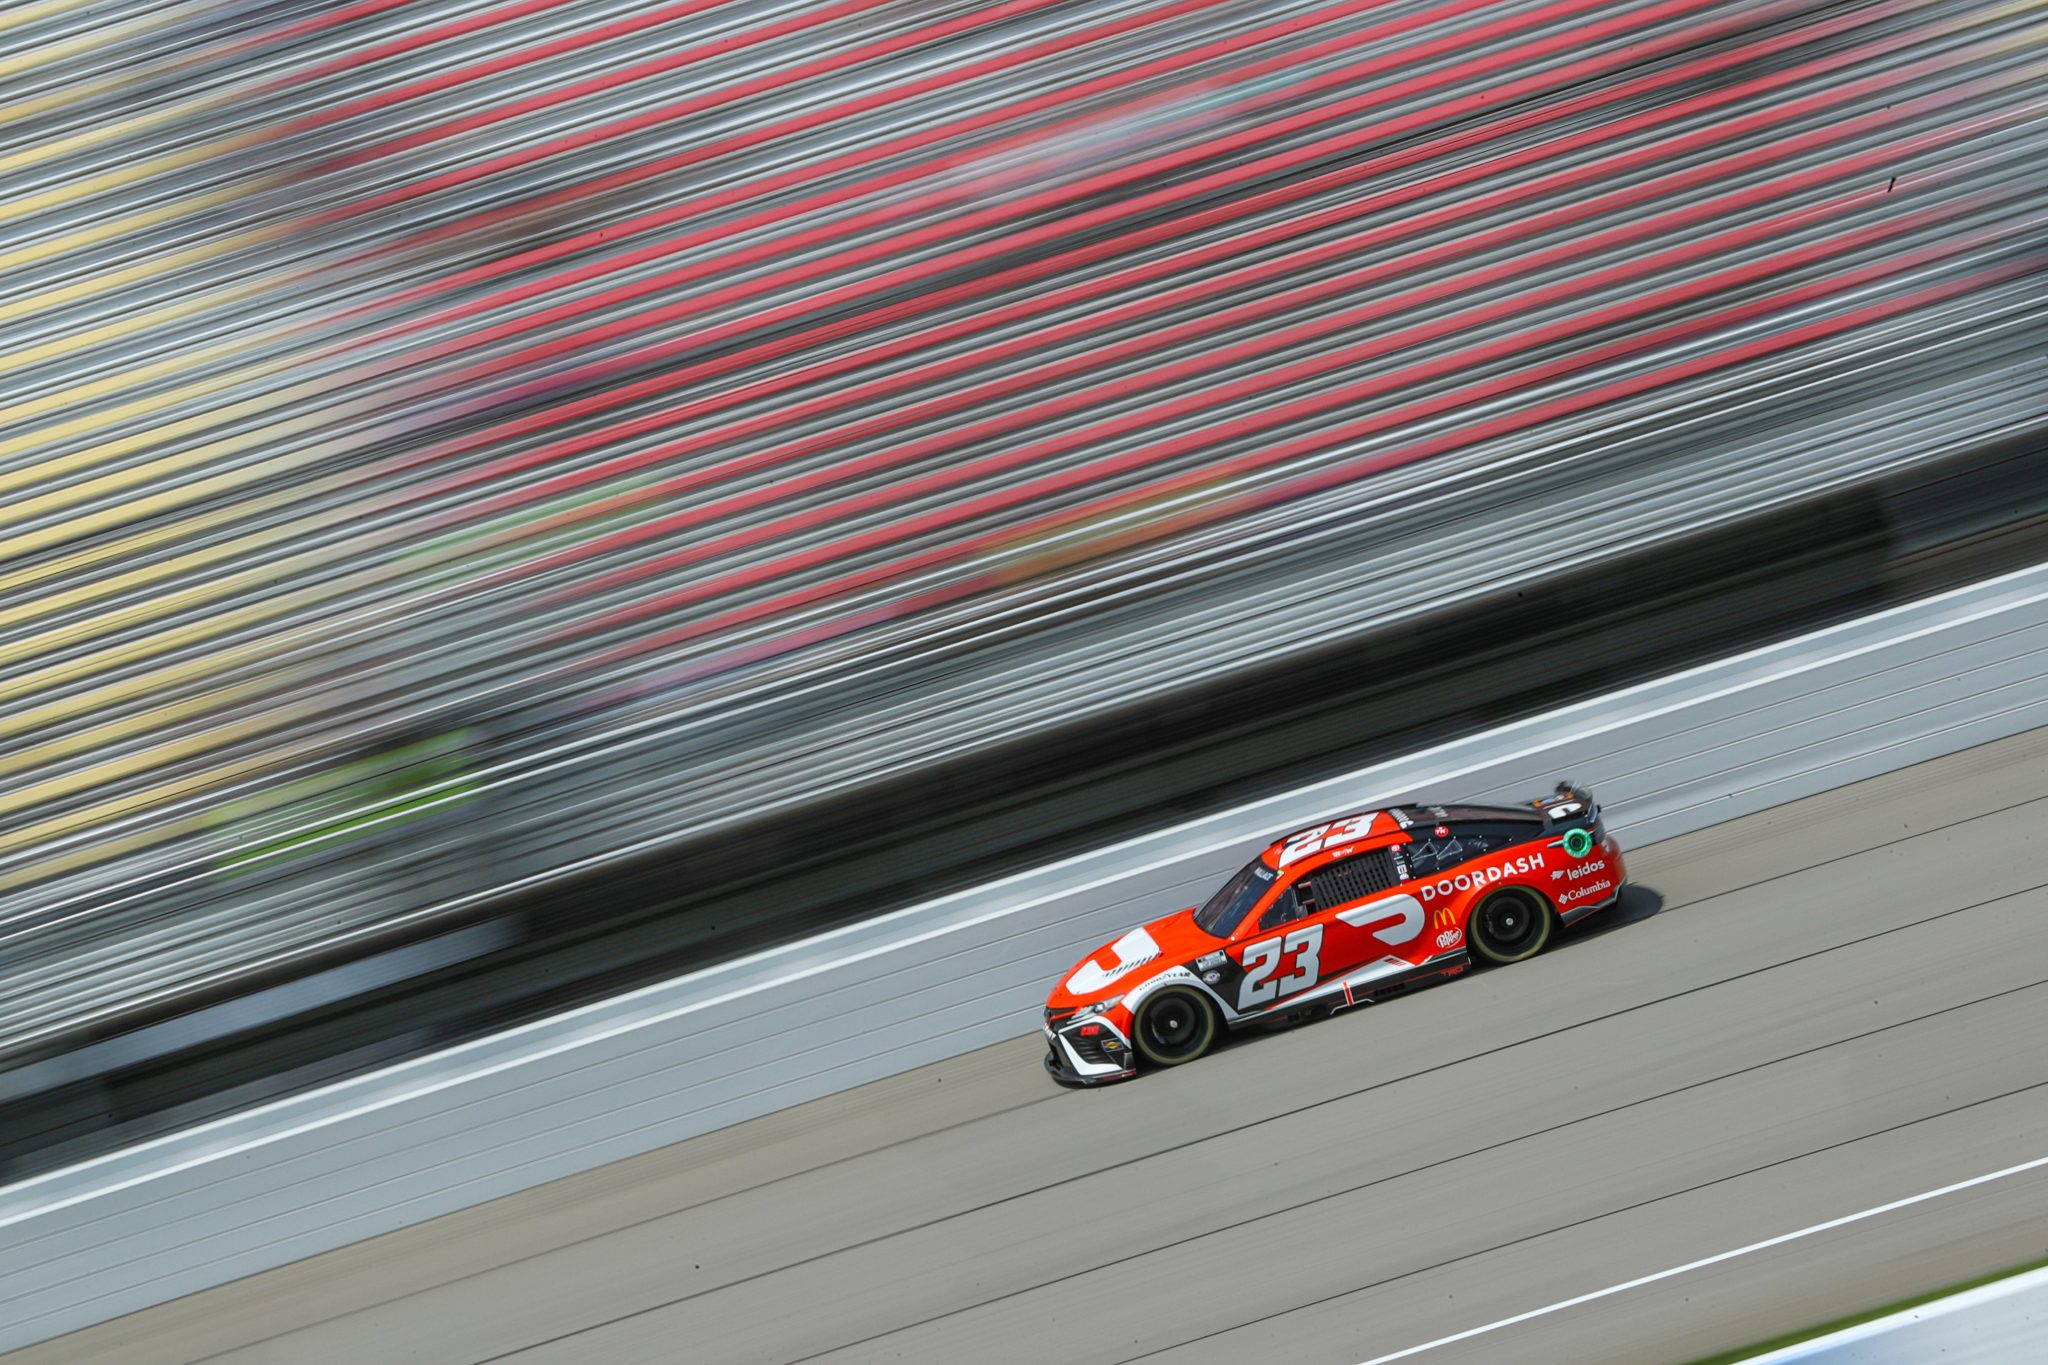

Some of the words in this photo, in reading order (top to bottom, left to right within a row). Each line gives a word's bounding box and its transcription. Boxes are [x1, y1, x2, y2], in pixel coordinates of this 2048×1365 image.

[1278, 811, 1380, 869] 23
[1420, 852, 1545, 902] DOORDASH
[1566, 859, 1606, 881] leidos
[1567, 879, 1612, 901] Columbia
[1237, 923, 1324, 1010] 23
